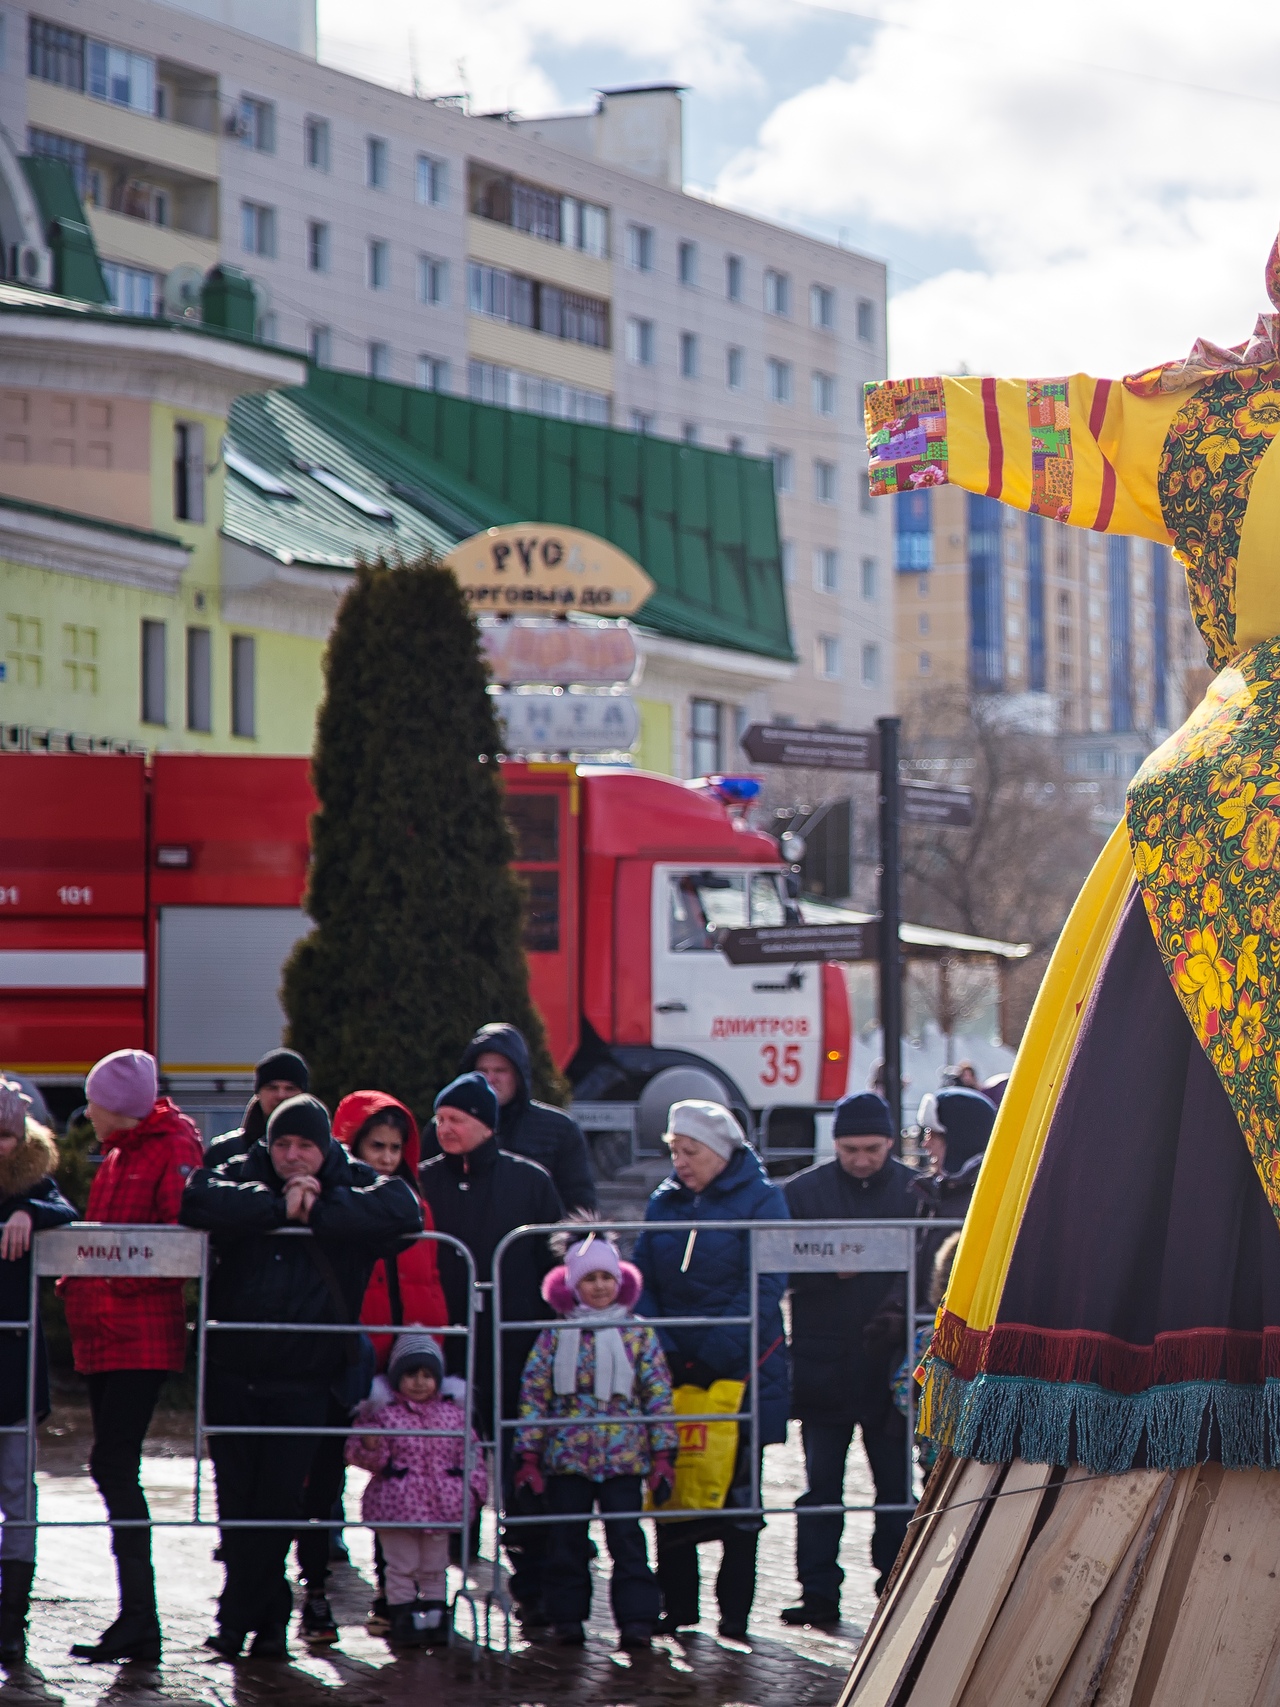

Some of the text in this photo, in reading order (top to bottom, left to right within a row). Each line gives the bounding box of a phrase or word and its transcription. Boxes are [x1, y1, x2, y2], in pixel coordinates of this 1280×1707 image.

[57, 886, 92, 904] 101
[711, 1016, 811, 1040] ДМИТРОВ
[760, 1044, 801, 1085] 35
[77, 1245, 122, 1262] МВД
[792, 1241, 835, 1258] МВД
